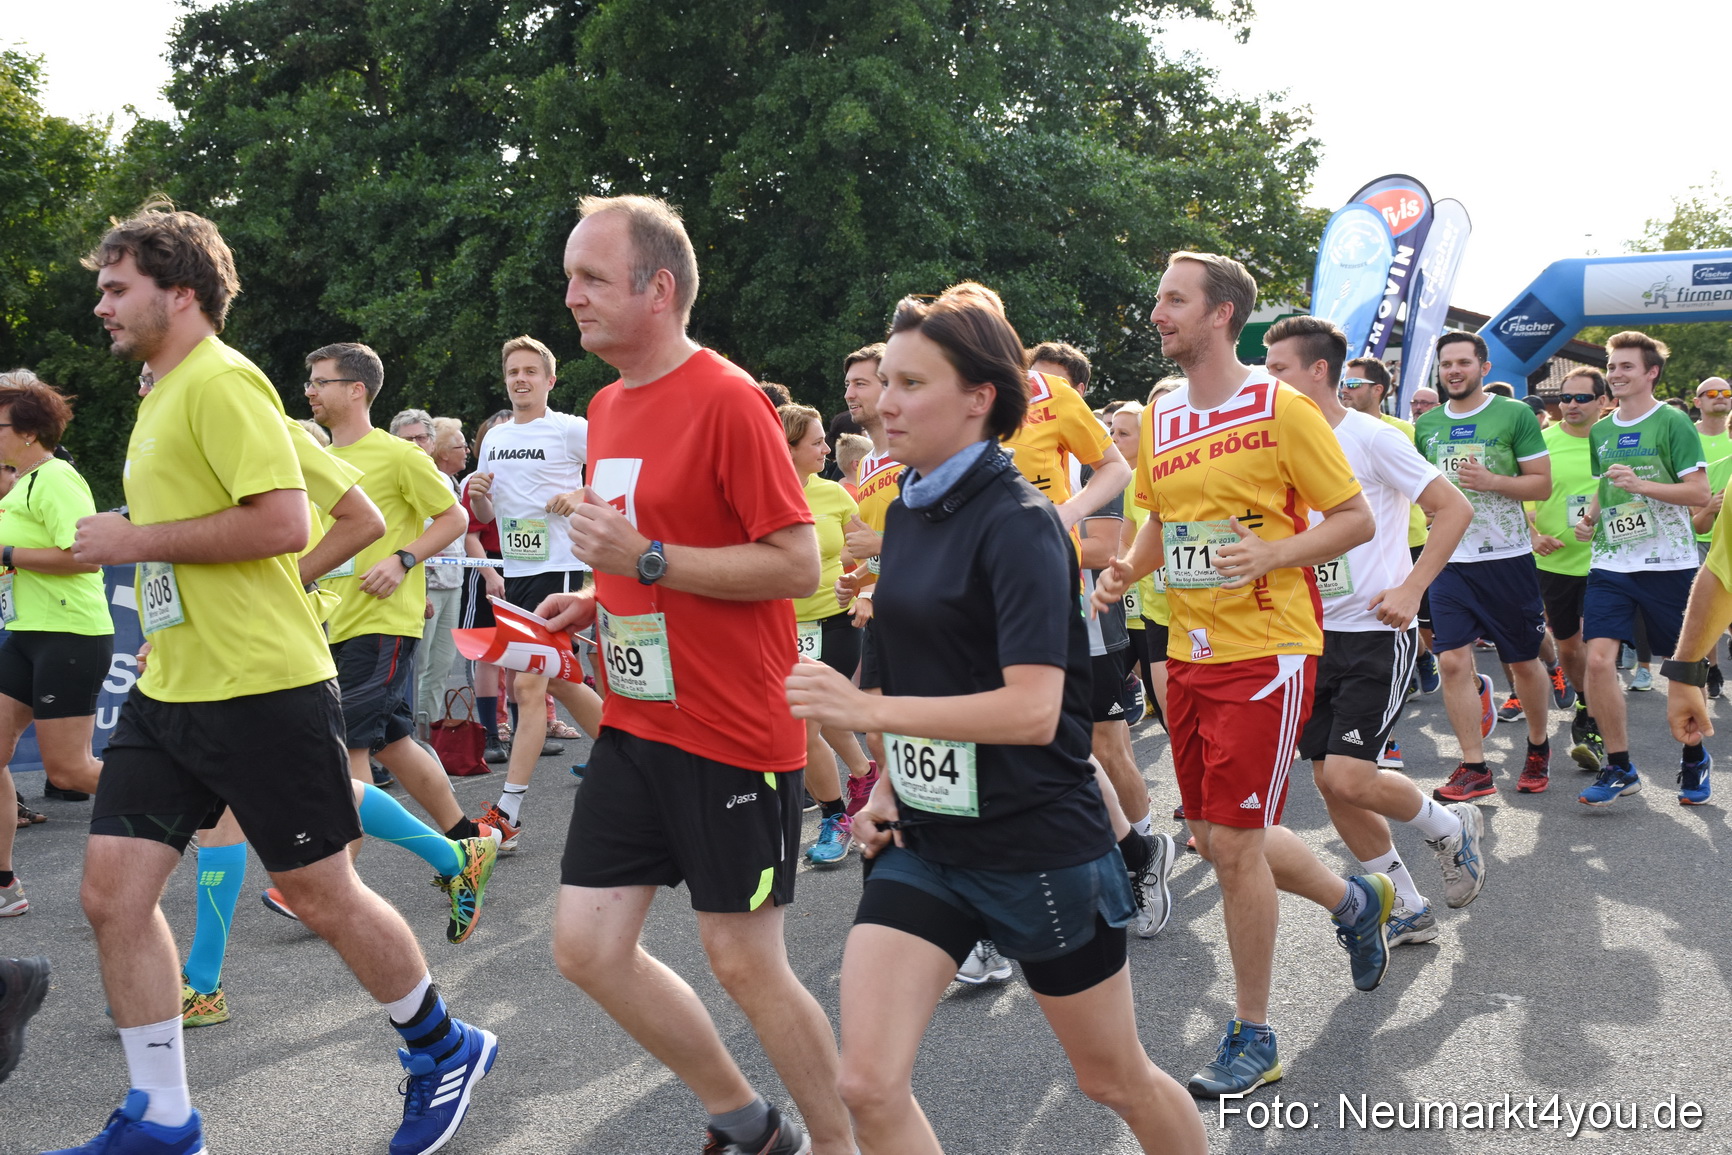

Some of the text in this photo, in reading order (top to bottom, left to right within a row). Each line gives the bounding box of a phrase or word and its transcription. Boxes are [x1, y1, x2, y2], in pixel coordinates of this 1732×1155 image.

[1508, 321, 1554, 332] Fischer
[497, 448, 546, 461] MAGNA
[1152, 431, 1278, 483] MAX BÖGL
[1608, 514, 1647, 535] 1634
[506, 532, 541, 549] 1504
[1172, 544, 1226, 570] 171
[143, 575, 173, 612] 1308
[1125, 594, 1135, 609] 6
[606, 641, 643, 677] 469
[1341, 735, 1364, 746] adidas
[892, 740, 960, 785] 1864
[736, 792, 758, 804] asics
